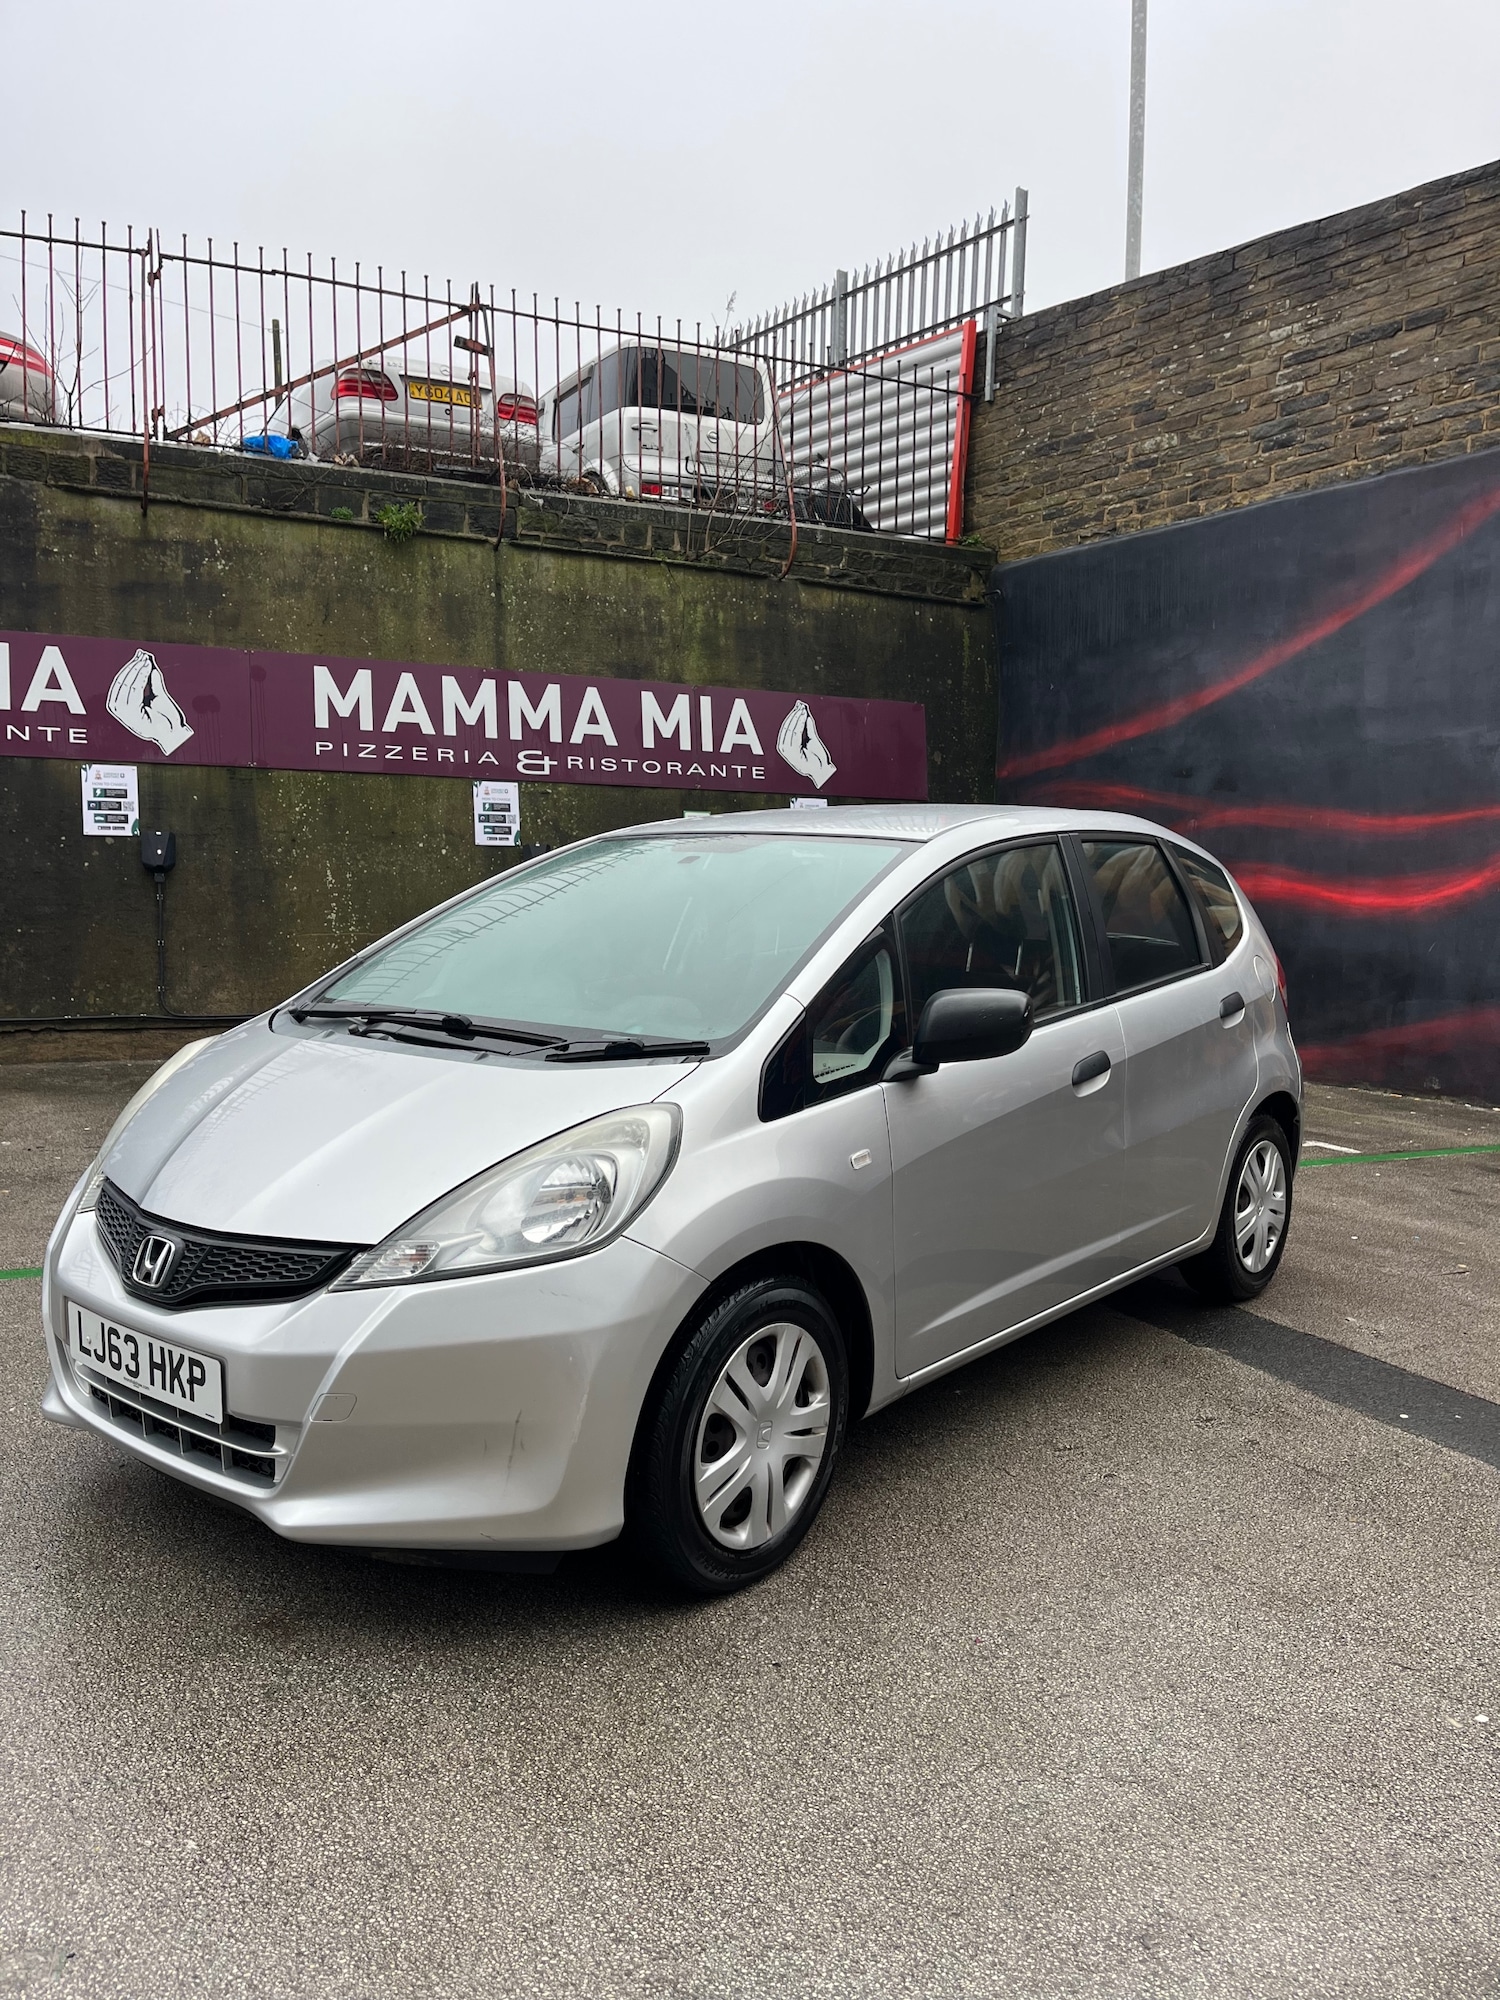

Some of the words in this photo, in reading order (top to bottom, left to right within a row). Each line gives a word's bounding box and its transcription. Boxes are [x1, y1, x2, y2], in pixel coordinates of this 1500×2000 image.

[6, 724, 88, 744] NTE
[313, 665, 619, 747] MAMMA
[640, 690, 764, 756] MIA
[315, 741, 500, 765] PIZZERIA
[516, 750, 558, 775] &
[567, 755, 766, 780] RISTORANTE
[77, 1310, 140, 1379] LJ63
[148, 1341, 206, 1403] HKP
